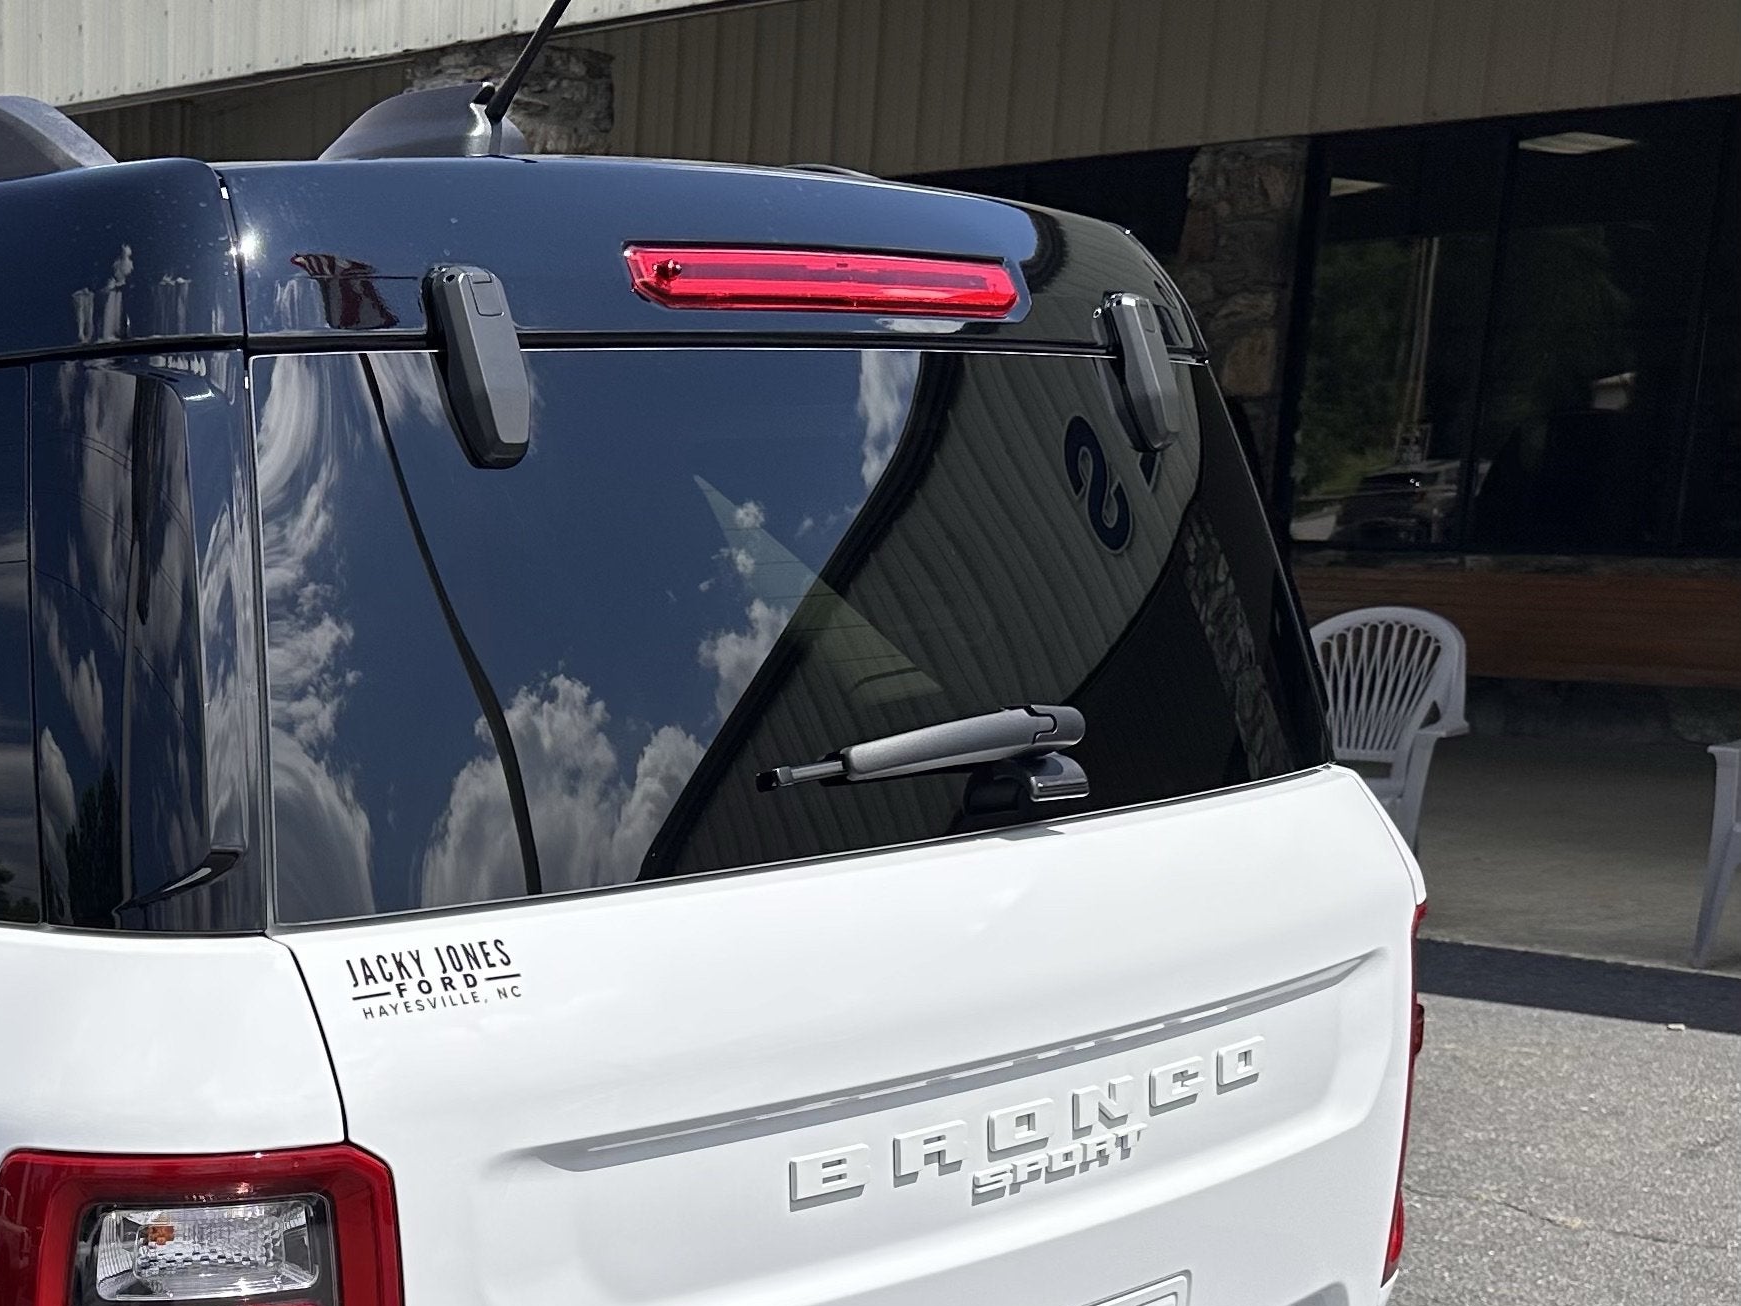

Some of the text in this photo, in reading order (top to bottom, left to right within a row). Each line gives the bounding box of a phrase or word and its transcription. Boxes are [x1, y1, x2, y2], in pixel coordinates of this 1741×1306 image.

[346, 938, 512, 988] JACKY JONES
[396, 973, 478, 998] FORD
[362, 984, 522, 1020] HAYESVILLE, NC
[789, 1036, 1266, 1210] BRONCO
[972, 1123, 1148, 1206] SPORT
